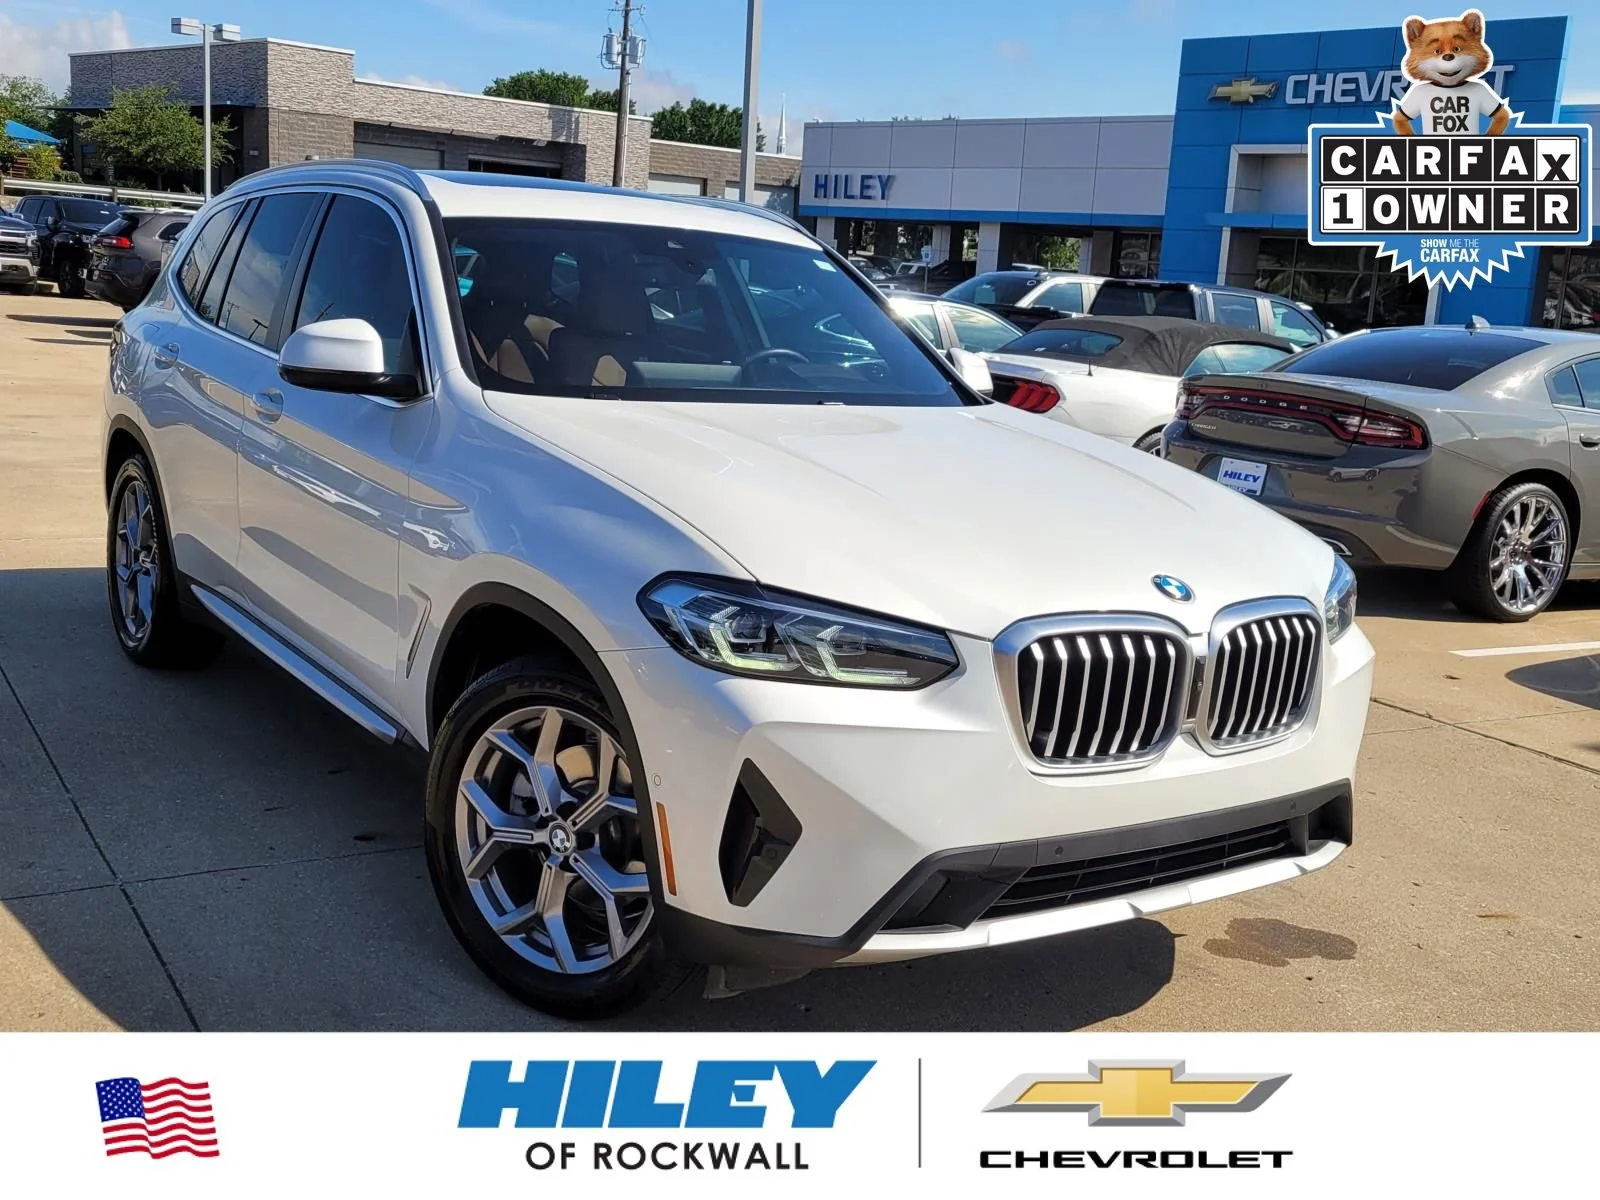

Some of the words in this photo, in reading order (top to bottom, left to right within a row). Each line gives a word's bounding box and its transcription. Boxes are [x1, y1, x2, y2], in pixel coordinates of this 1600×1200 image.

[1285, 65, 1514, 104] CHEVRT
[814, 174, 896, 200] HILEY
[1223, 395, 1308, 410] DODGE
[1223, 470, 1261, 483] HILEY
